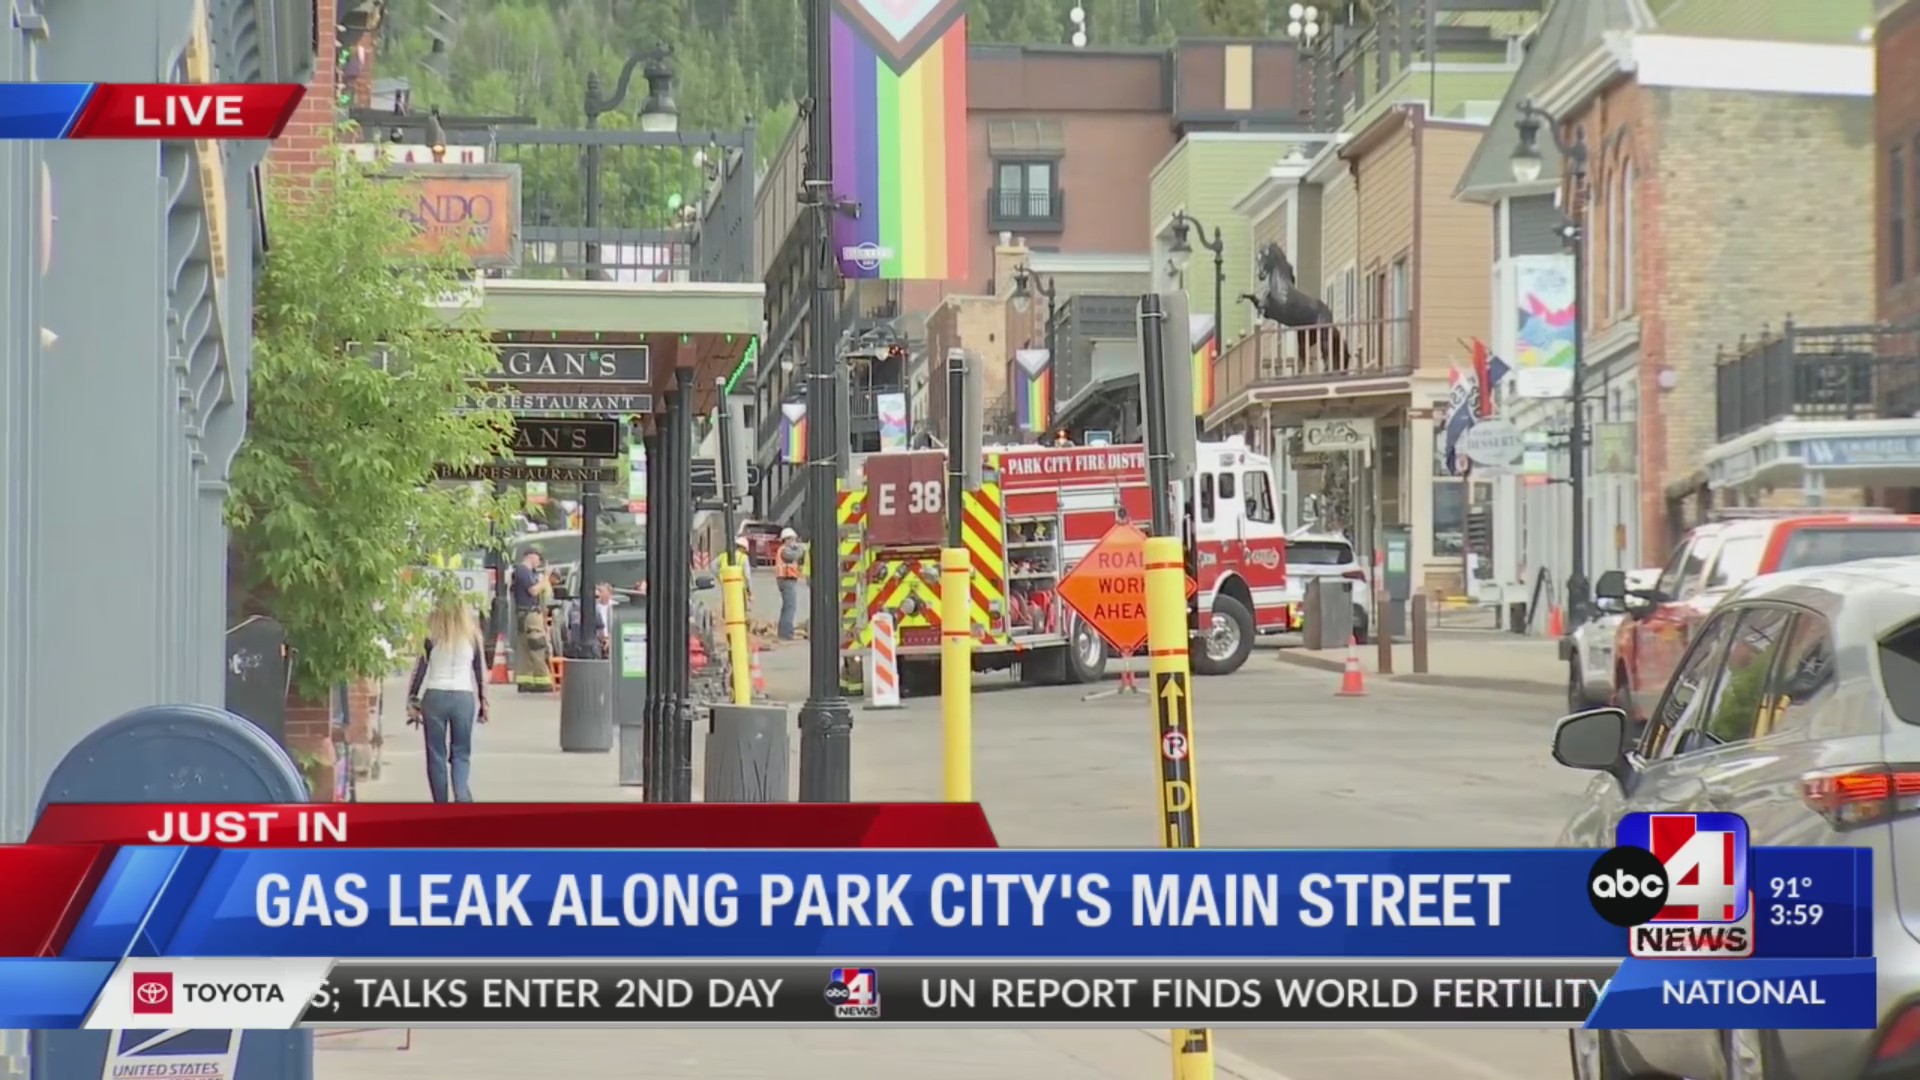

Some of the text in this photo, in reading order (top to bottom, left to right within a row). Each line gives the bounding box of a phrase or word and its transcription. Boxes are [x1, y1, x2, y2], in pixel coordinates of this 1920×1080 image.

[496, 394, 634, 409] RESTAURANT
[1008, 452, 1144, 475] PARK CITY FIRE DISTR
[478, 466, 602, 480] RESTAURANT
[878, 480, 942, 516] E 38
[1093, 602, 1146, 620] AHEA
[112, 1062, 220, 1077] UNITED STATES
